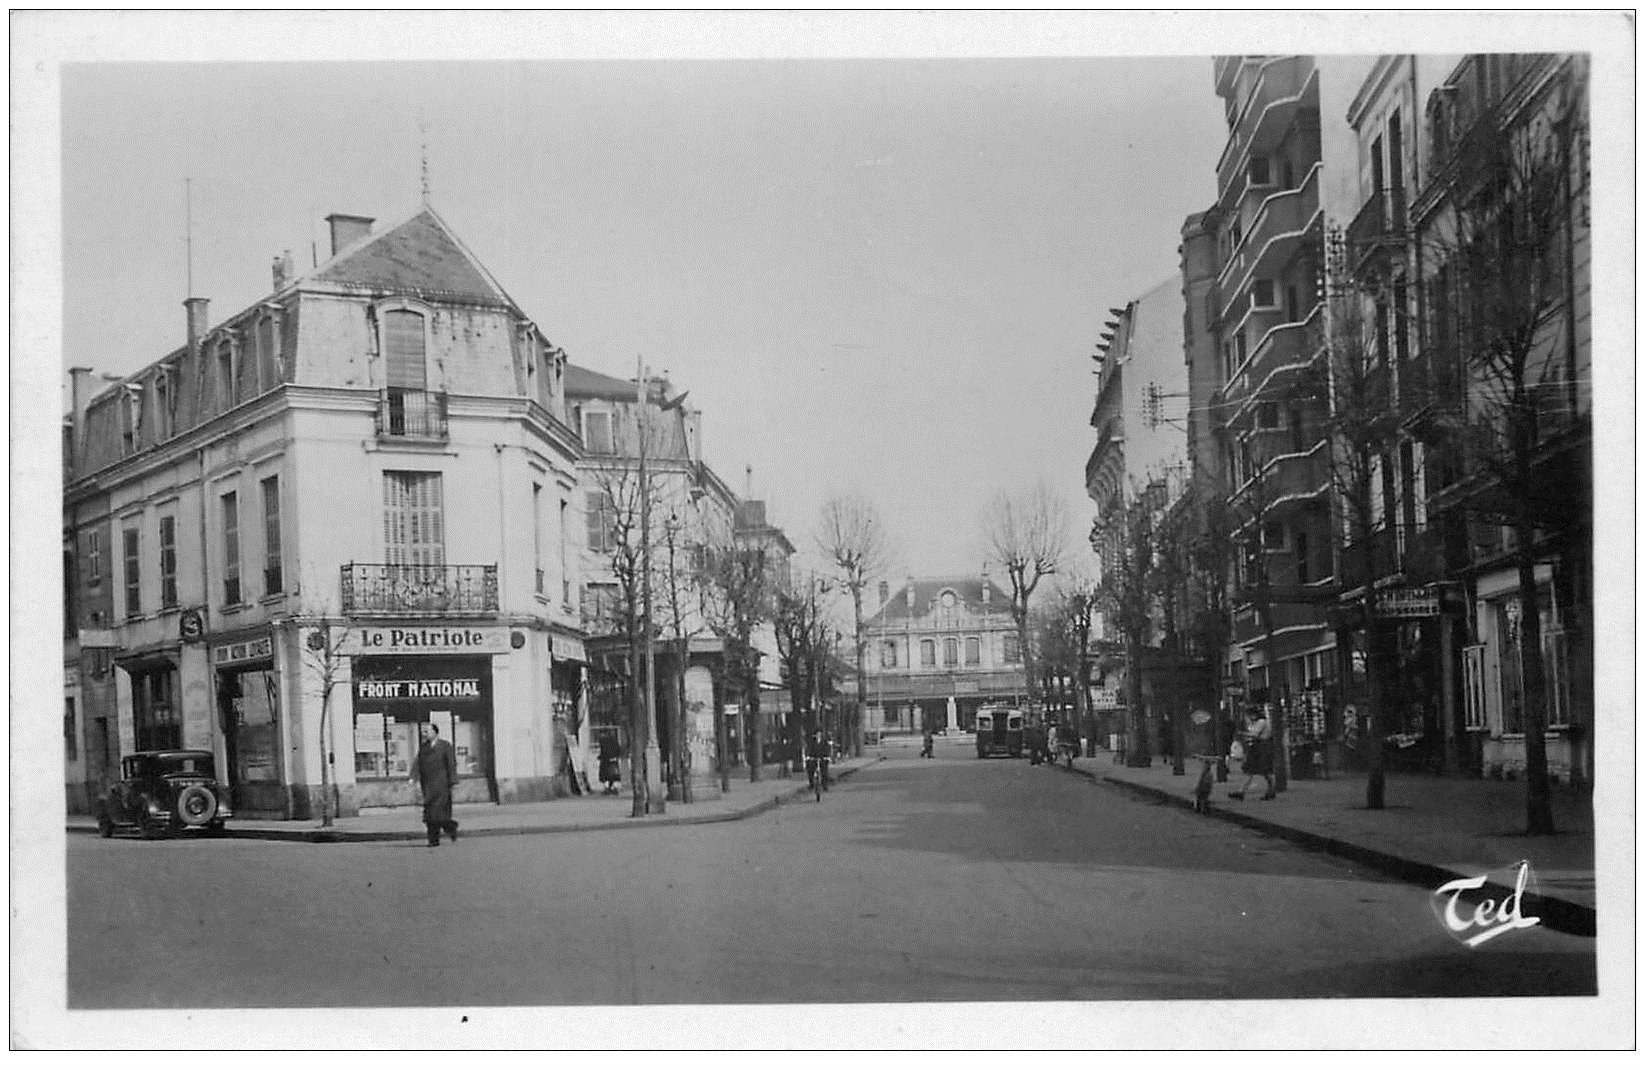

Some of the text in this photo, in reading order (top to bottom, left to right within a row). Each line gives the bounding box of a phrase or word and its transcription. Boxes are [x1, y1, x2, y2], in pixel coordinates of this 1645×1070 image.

[361, 629, 482, 646] Le Patriote
[359, 682, 479, 697] FRONT NATIONAL
